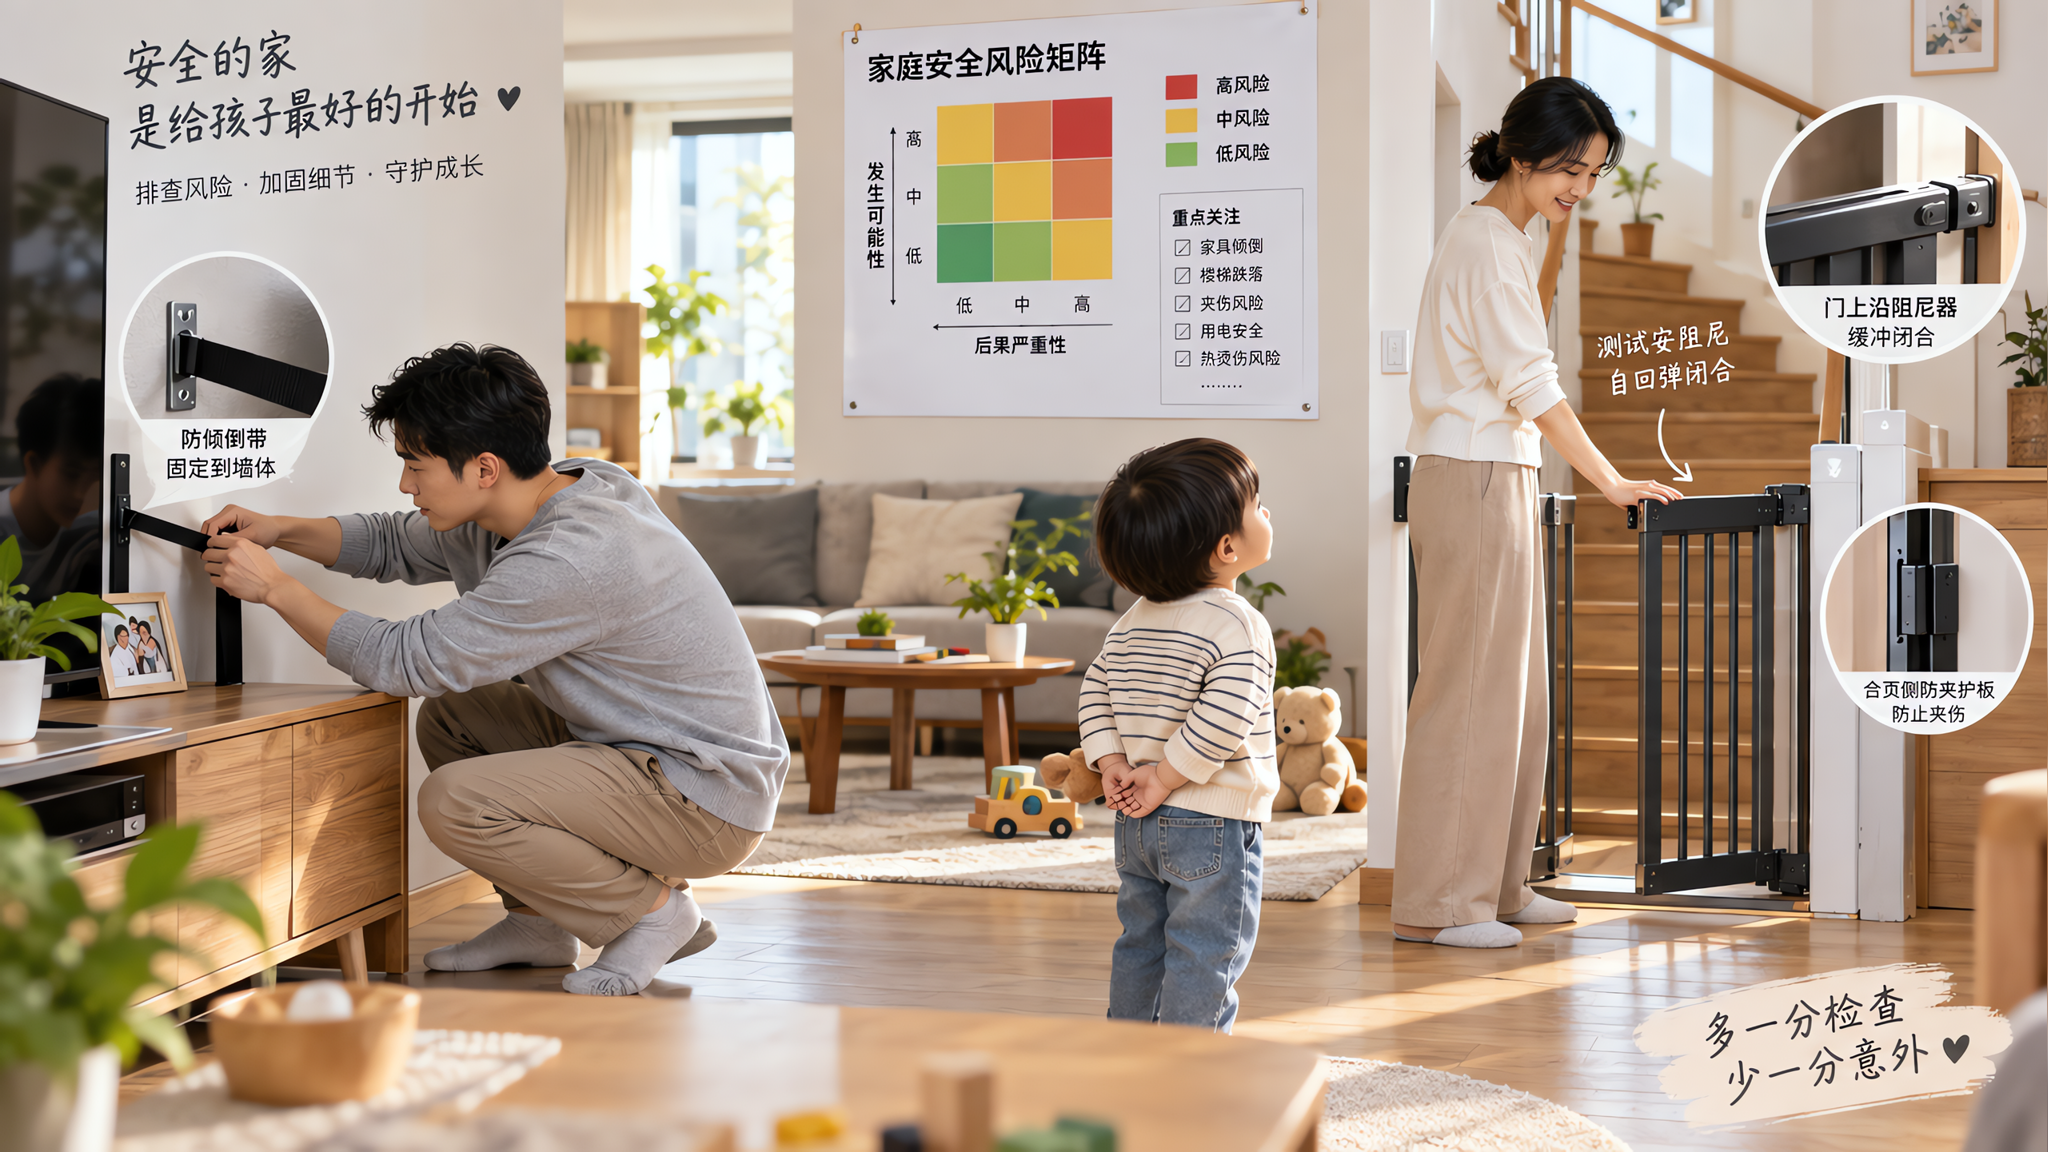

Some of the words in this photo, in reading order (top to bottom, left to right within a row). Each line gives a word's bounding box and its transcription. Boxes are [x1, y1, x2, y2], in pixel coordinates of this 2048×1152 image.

[868, 39, 1107, 84] 家庭安全风险矩阵
[1216, 73, 1270, 96] 高风险
[1216, 107, 1270, 129] 中风险
[906, 129, 922, 148] 高
[1215, 142, 1270, 164] 低风险
[906, 187, 922, 206] 中
[866, 161, 886, 270] 发生可能性
[1171, 206, 1241, 228] 重点关注
[905, 246, 923, 265] 低
[955, 296, 973, 315] 低
[1014, 295, 1030, 314] 中
[1073, 294, 1091, 314] 高
[1200, 294, 1264, 313] 夹伤风险
[1200, 322, 1264, 340] 用电安全
[974, 334, 1067, 355] 后果严重性
[1200, 349, 1281, 367] 热烫伤风险
